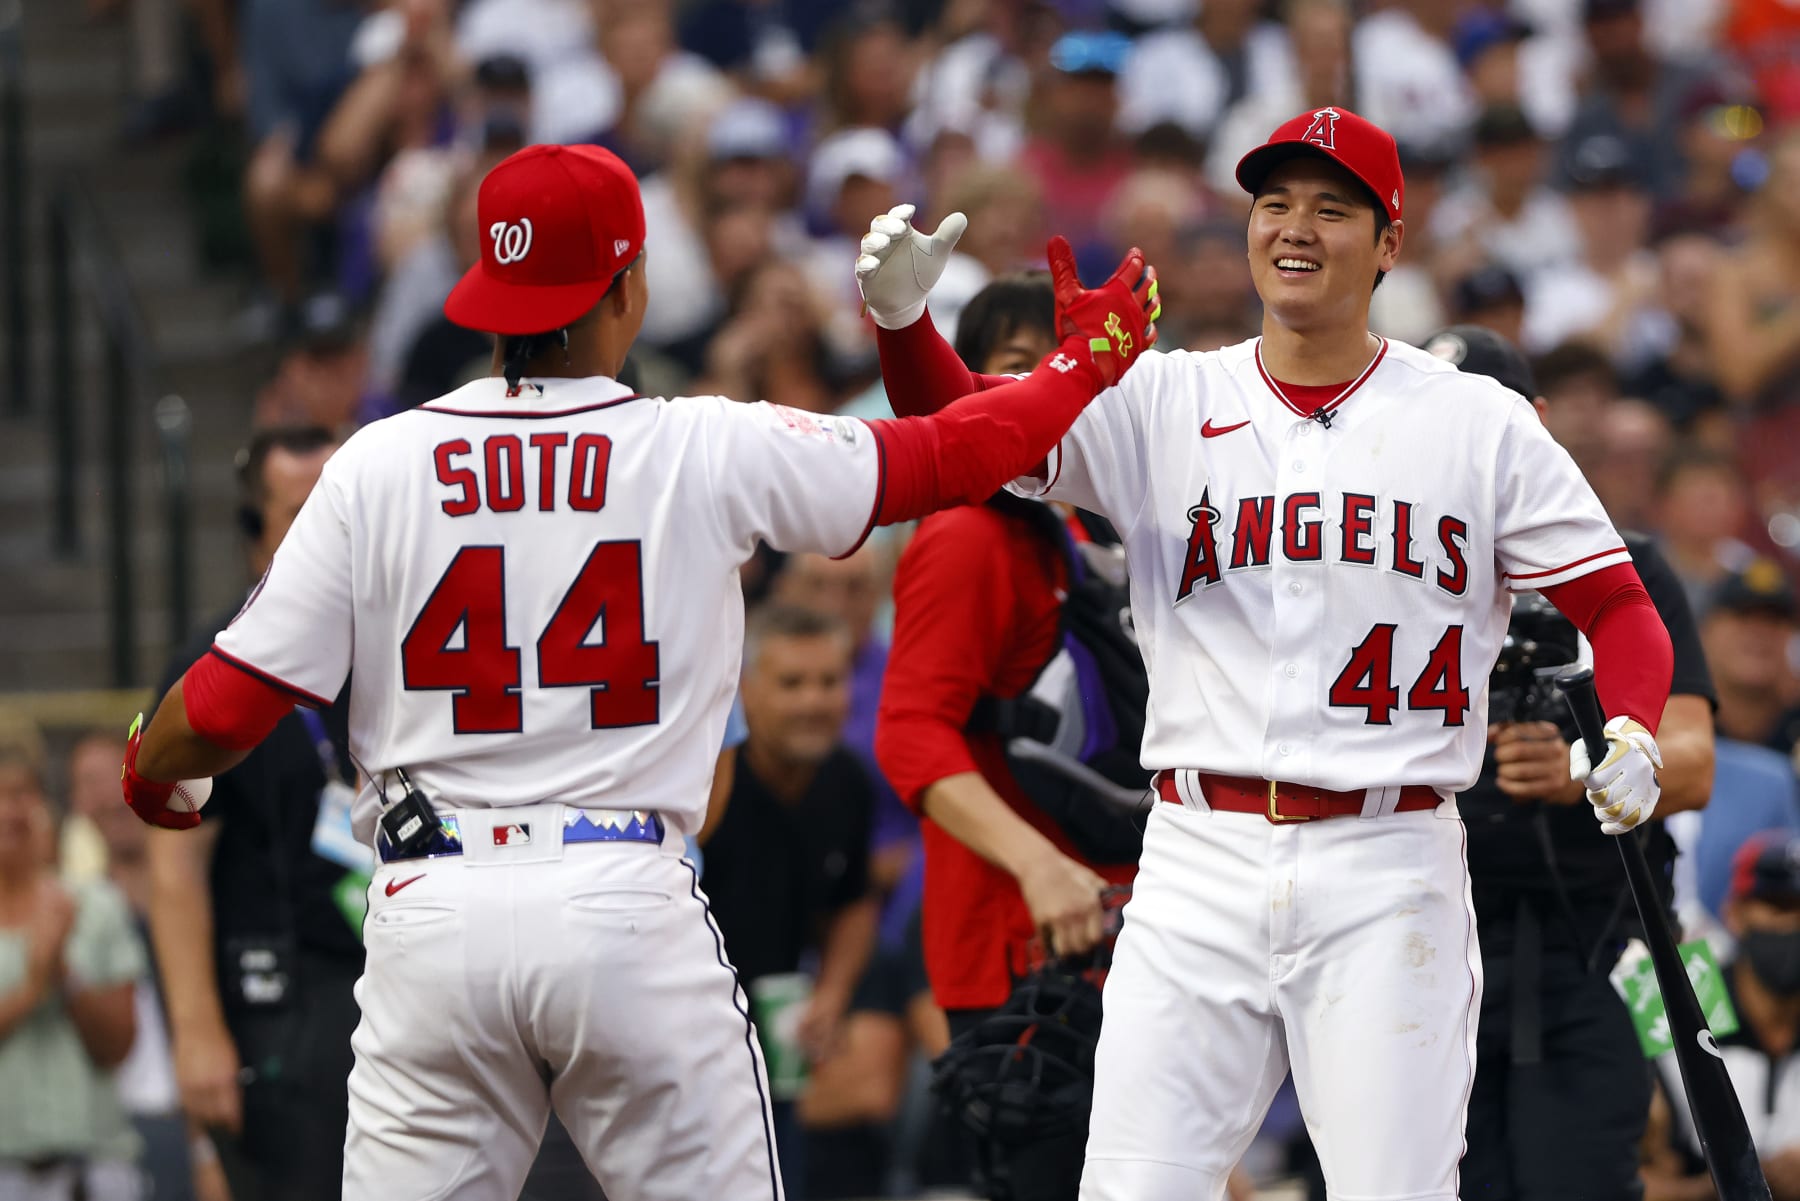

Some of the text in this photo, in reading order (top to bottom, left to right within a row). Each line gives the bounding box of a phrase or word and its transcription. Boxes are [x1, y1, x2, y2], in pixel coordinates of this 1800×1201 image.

[489, 216, 534, 266] W
[433, 431, 613, 518] SOTO
[1173, 480, 1471, 608] ANGELS
[401, 538, 661, 735] 44
[1328, 622, 1471, 727] 44
